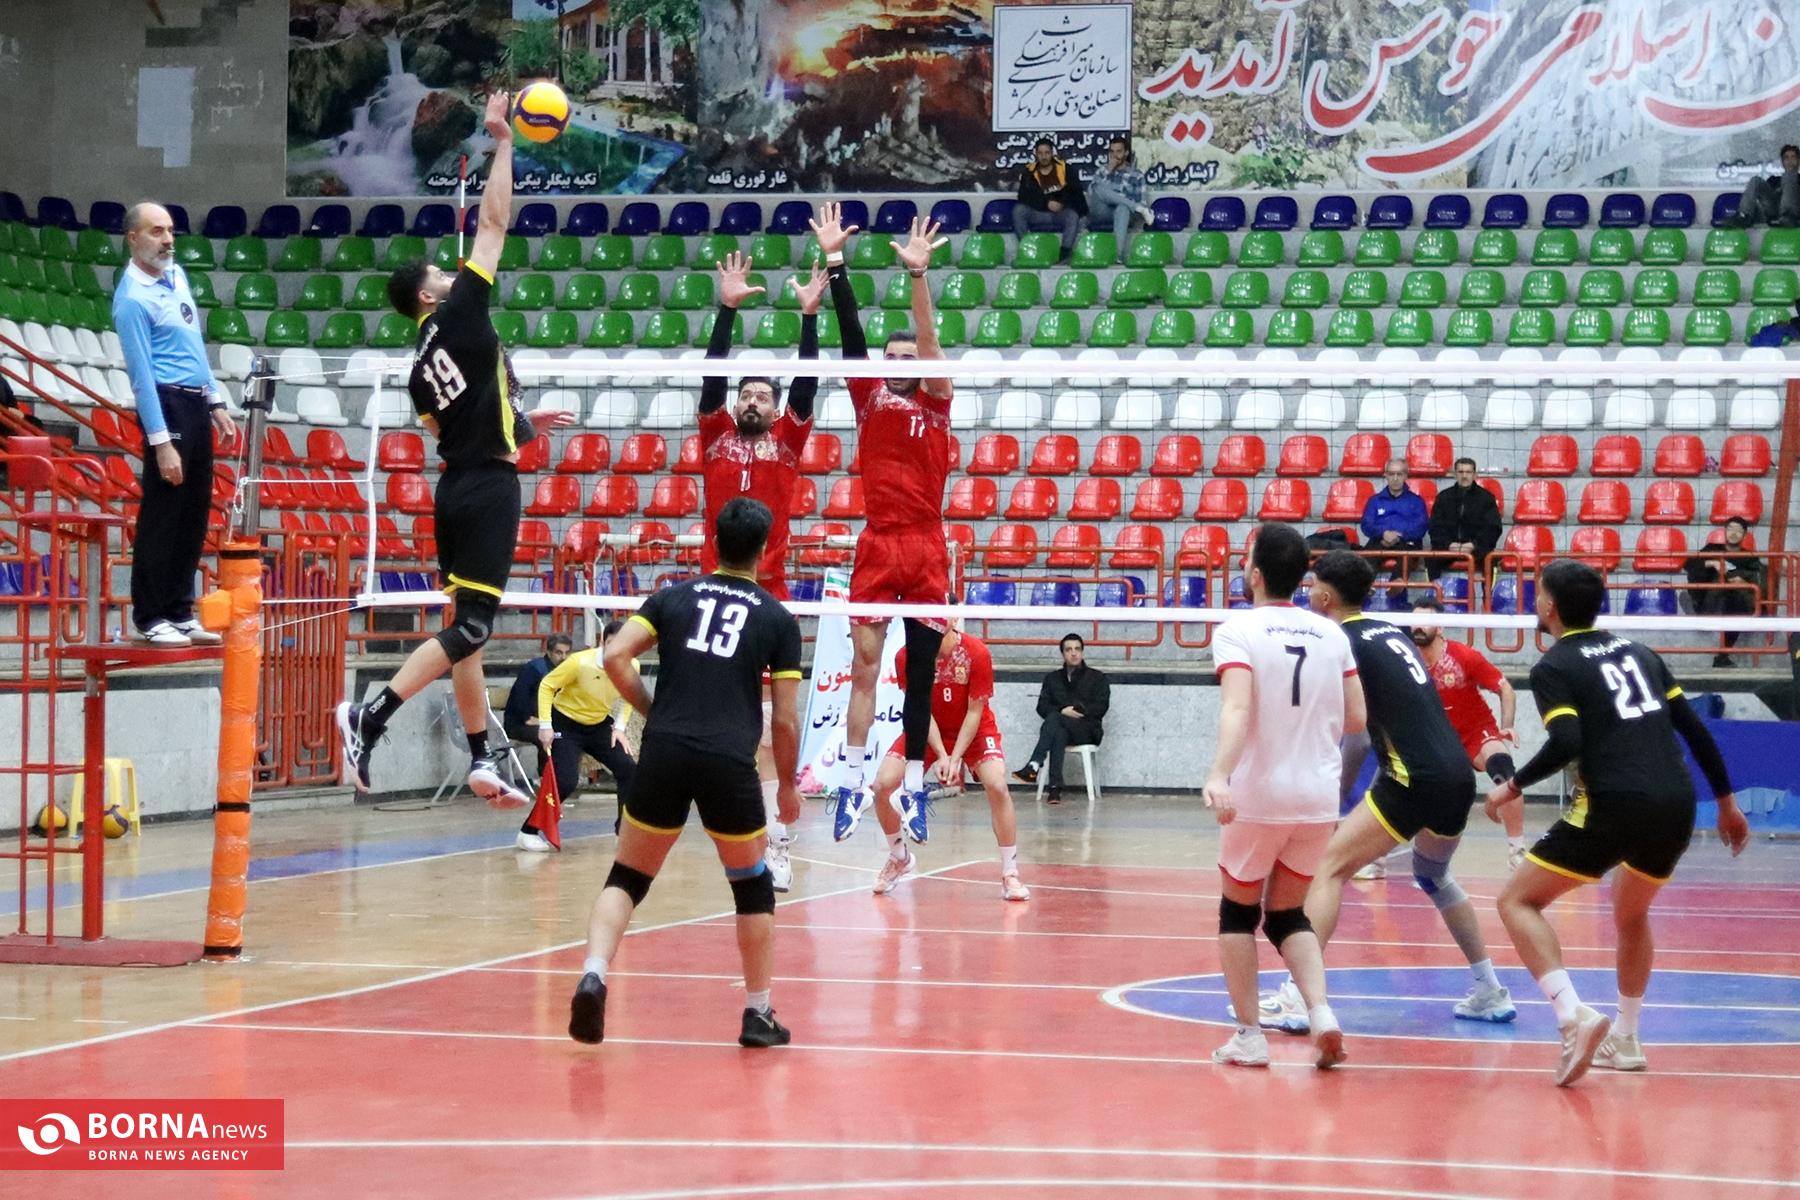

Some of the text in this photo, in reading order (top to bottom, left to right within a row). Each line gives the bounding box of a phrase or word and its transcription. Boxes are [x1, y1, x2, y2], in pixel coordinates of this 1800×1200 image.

[1069, 55, 1119, 83] سازمان
[573, 172, 598, 187] تکیه
[707, 169, 788, 189] غار قوری قلعه
[1181, 163, 1217, 184] آبشار
[423, 348, 467, 411] 19
[686, 597, 749, 658] 13
[1284, 644, 1307, 707] 7
[1386, 638, 1427, 685] 3
[942, 687, 953, 703] 8
[1601, 655, 1662, 720] 21
[985, 736, 996, 749] 8
